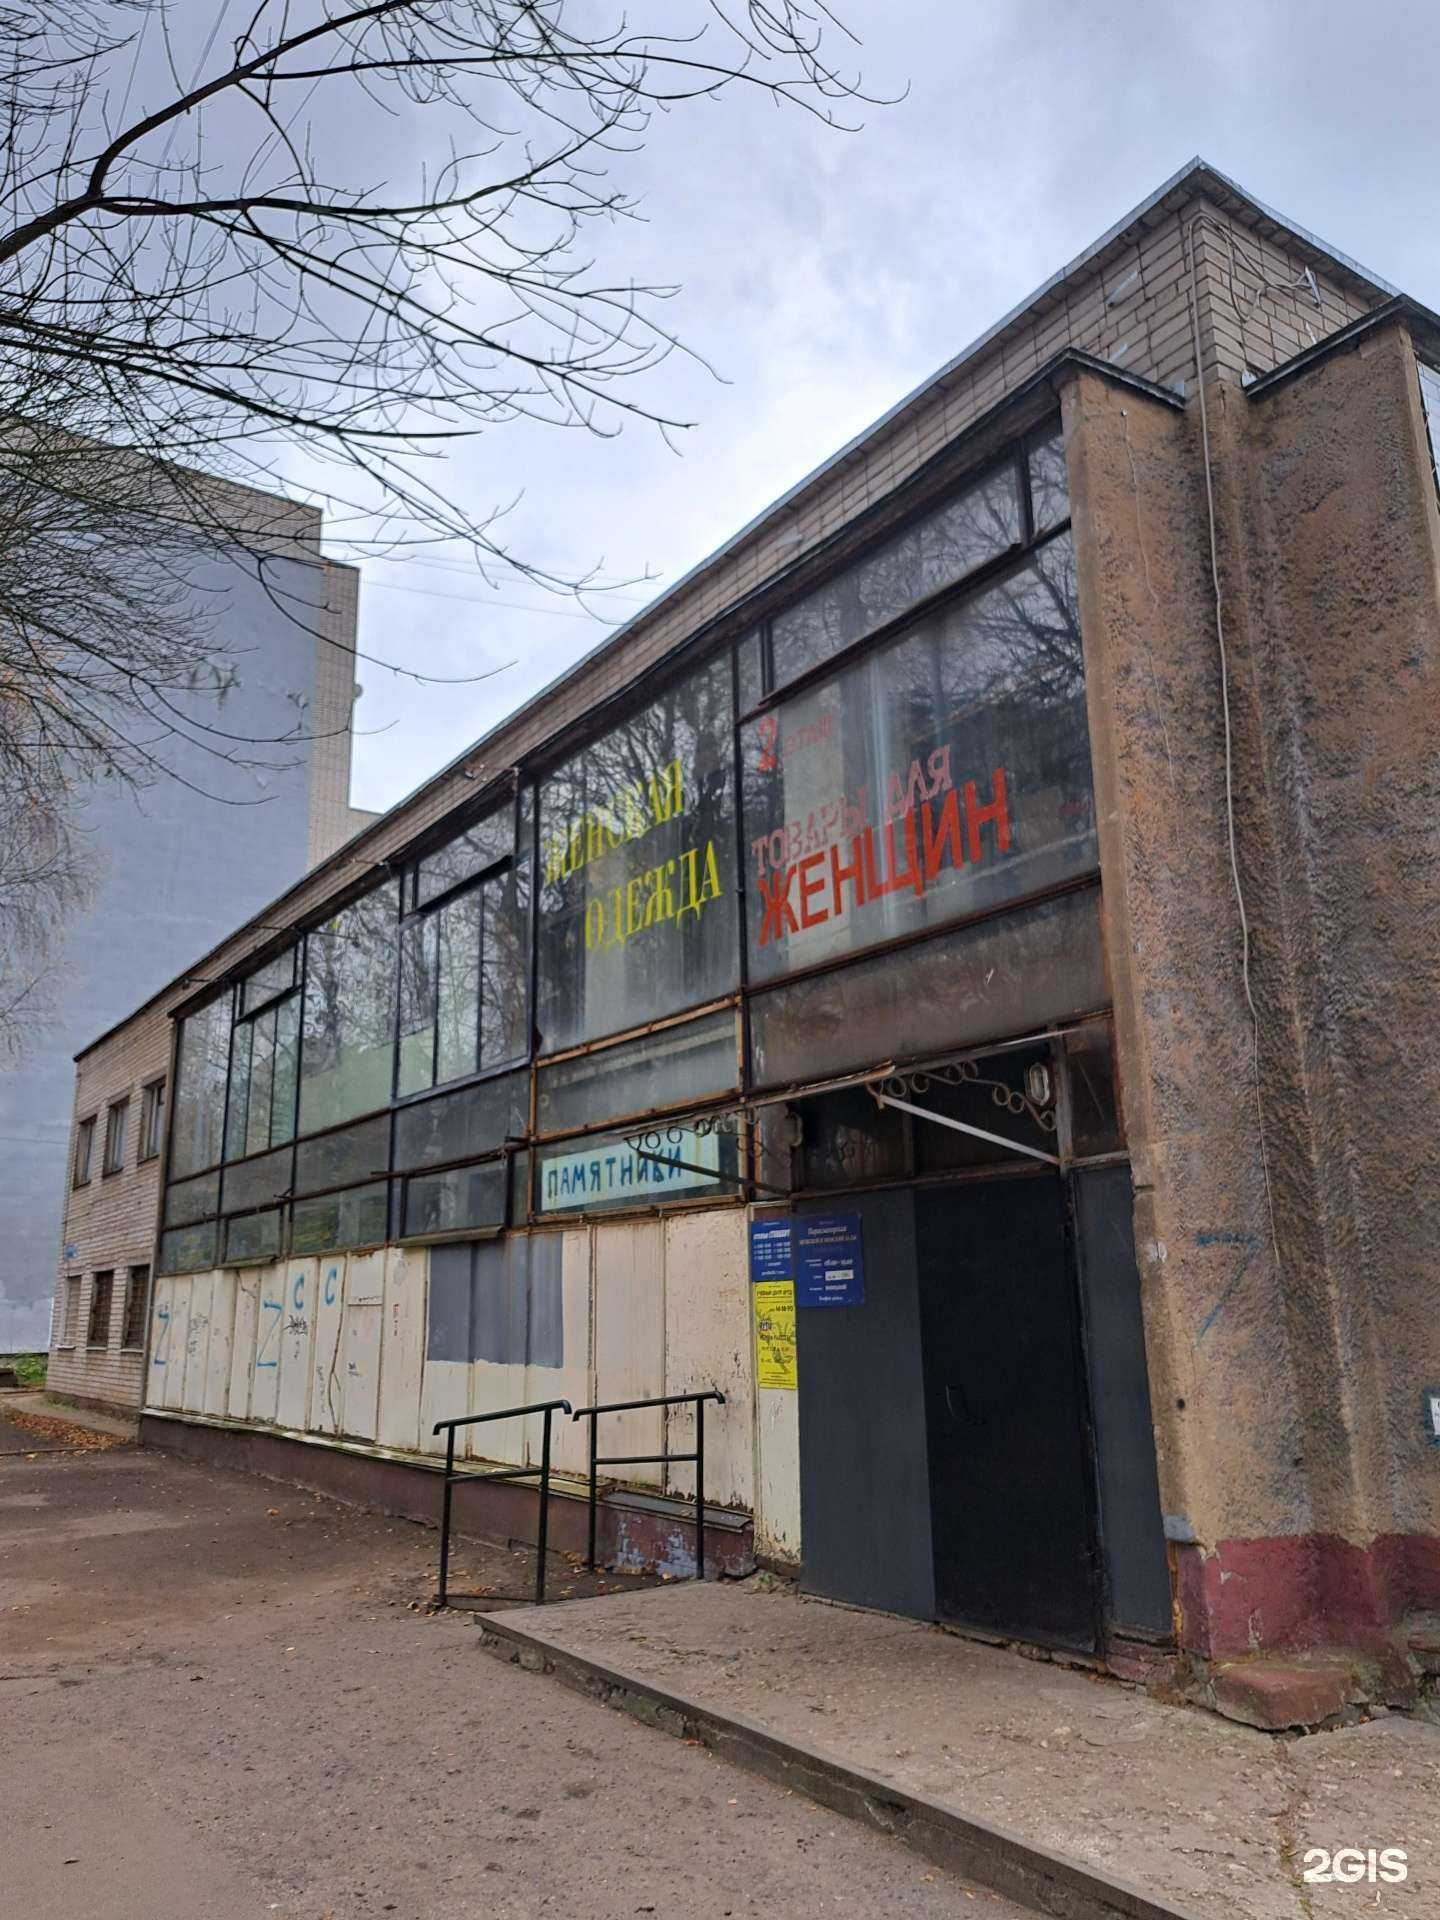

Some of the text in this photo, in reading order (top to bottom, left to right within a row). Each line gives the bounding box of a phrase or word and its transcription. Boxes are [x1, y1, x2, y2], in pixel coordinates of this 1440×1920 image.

[751, 743, 953, 877] ТОВАРЫ ДЛЯ
[756, 767, 1012, 946] ЖЕНЩИН
[584, 840, 723, 951] ОДЕЖДА
[547, 1145, 682, 1198] ПАМЯТНИКИ
